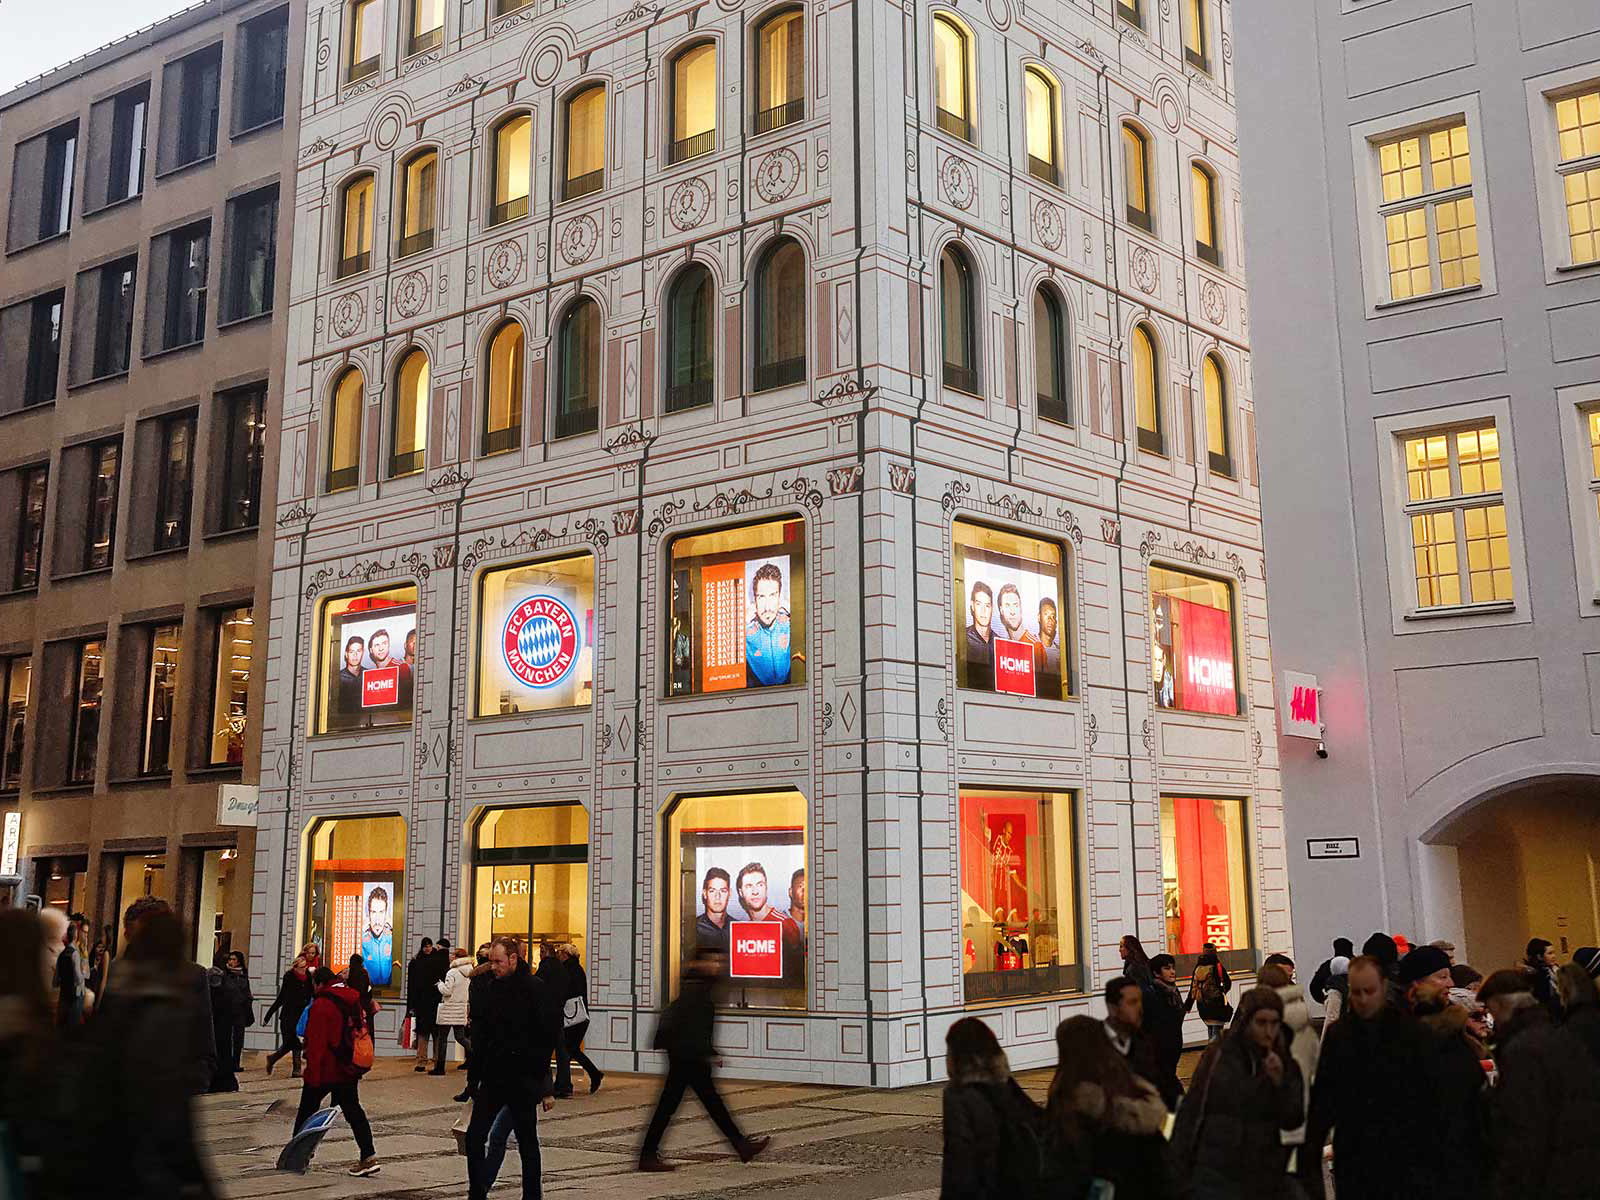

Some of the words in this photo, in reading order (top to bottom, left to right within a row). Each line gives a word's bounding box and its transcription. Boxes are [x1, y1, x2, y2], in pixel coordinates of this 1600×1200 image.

[508, 614, 523, 635] FC
[523, 601, 573, 638] BAYERN
[1000, 655, 1030, 673] HOME
[1188, 655, 1234, 690] HOME
[367, 679, 394, 691] HOME
[737, 939, 776, 953] HOME
